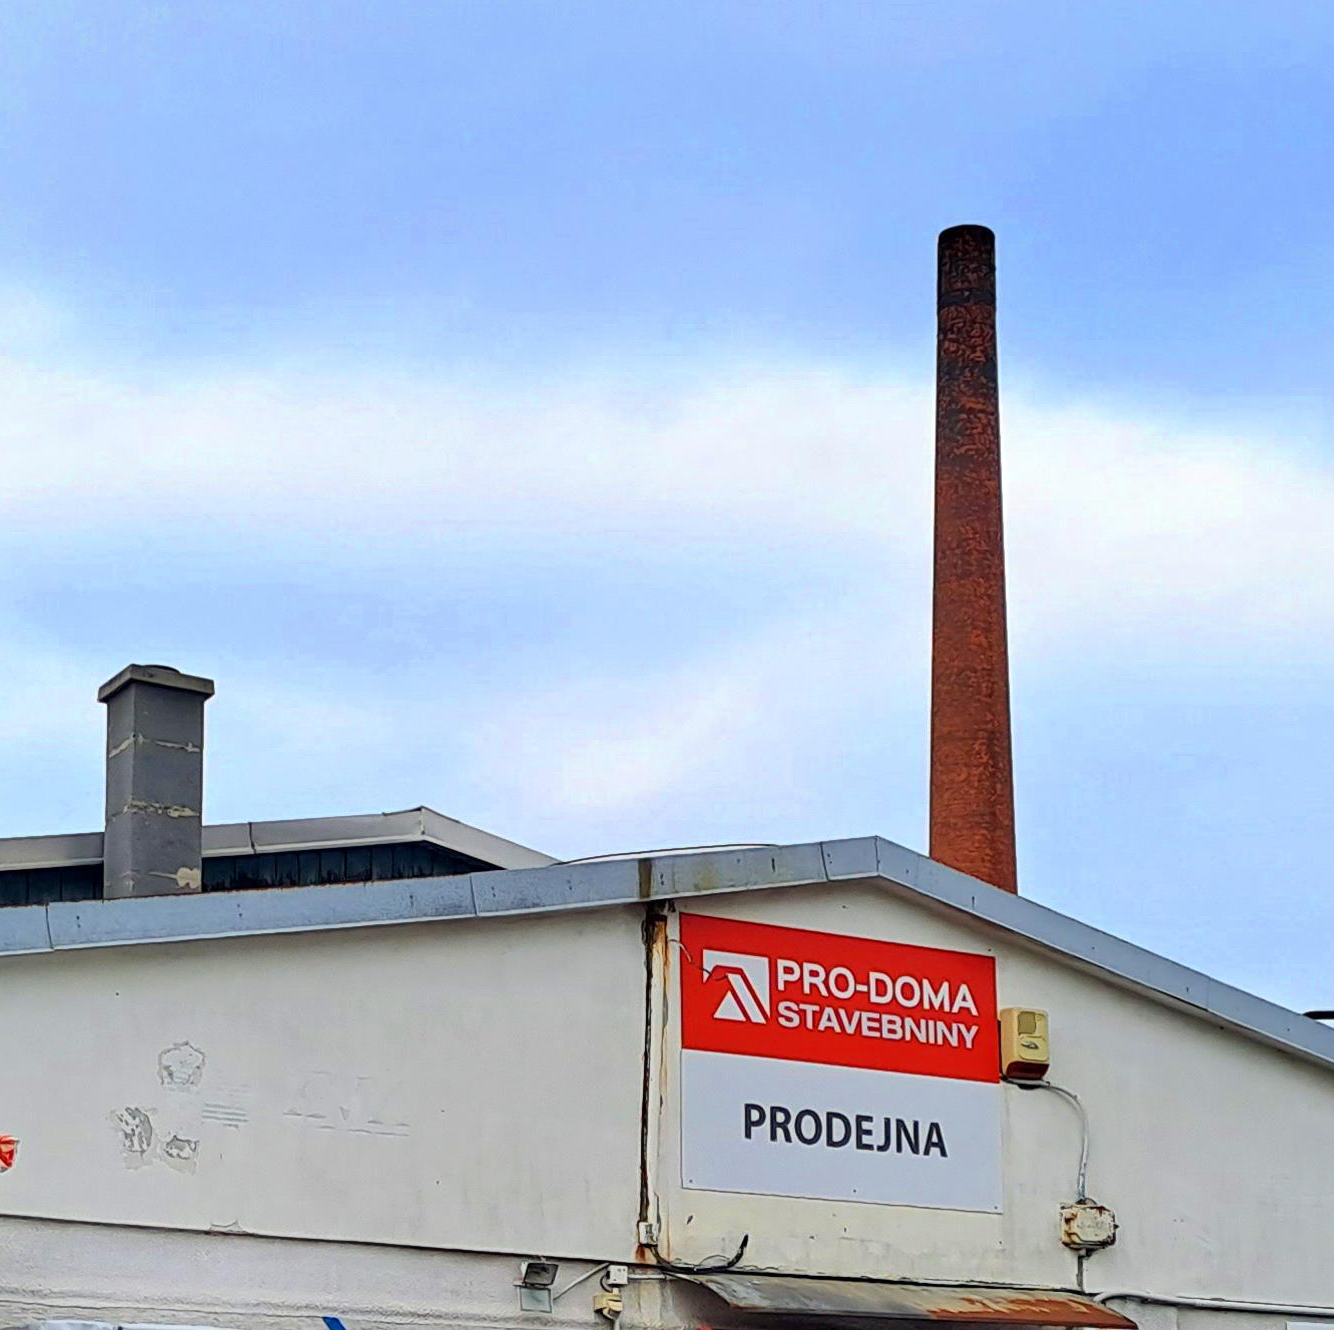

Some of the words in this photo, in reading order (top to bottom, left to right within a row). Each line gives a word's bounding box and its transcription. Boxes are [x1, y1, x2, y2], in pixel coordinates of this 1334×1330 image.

[777, 958, 979, 1016] PRO-DOMA
[777, 1001, 979, 1049] STAVEBNINY
[744, 1103, 948, 1158] PRODEJNA
